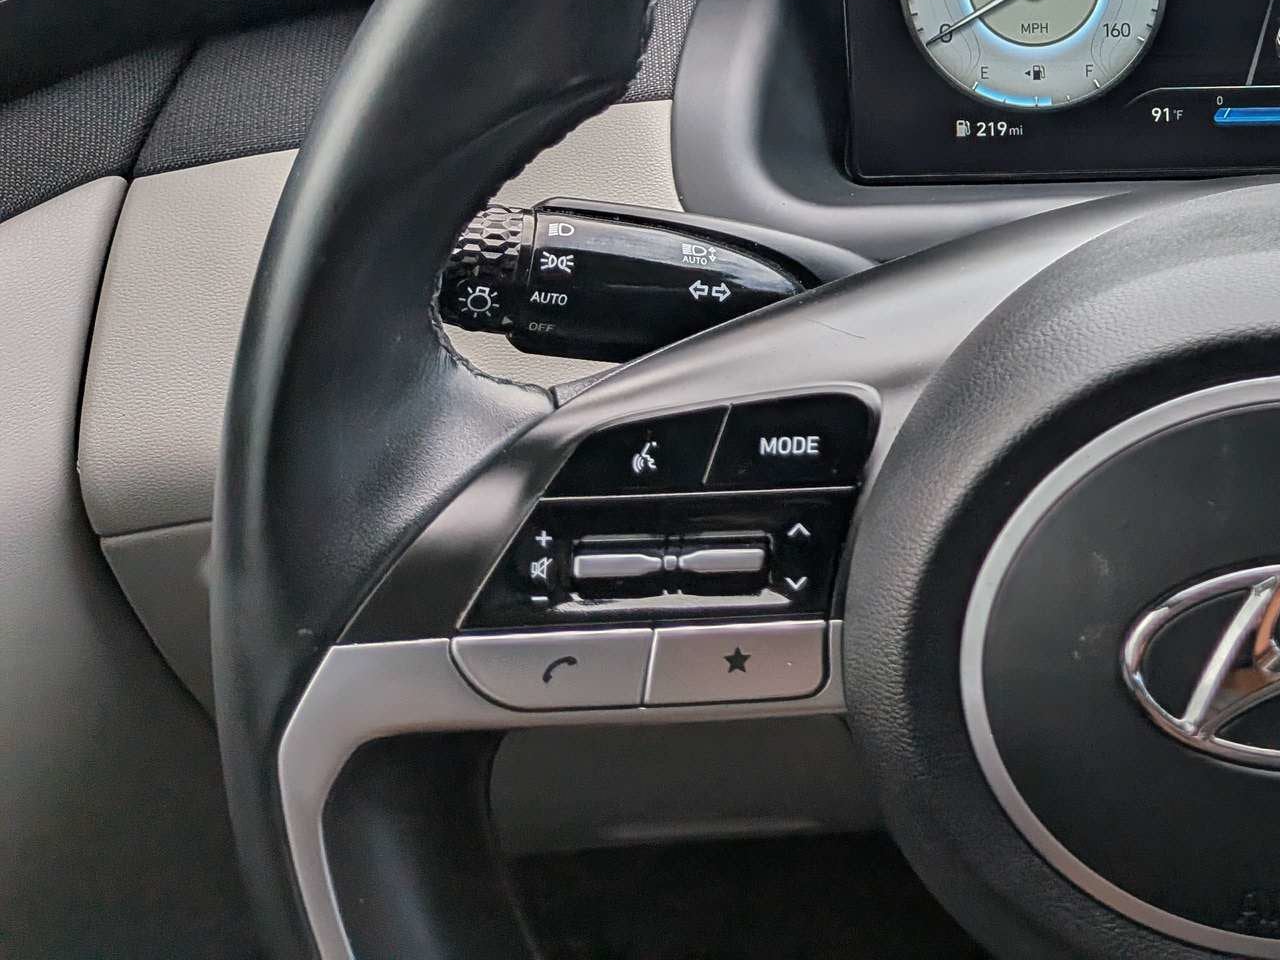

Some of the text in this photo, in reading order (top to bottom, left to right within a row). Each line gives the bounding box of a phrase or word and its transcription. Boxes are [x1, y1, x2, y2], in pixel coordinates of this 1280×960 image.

[1020, 22, 1049, 35] MPH
[1103, 22, 1131, 38] 160
[980, 66, 989, 80] E
[1085, 64, 1093, 78] F
[1216, 96, 1223, 106] 0
[1151, 107, 1171, 122] 91
[976, 121, 1008, 137] 219
[682, 255, 708, 265] AUTO
[530, 291, 568, 306] AUTO
[529, 321, 555, 333] OFF
[760, 436, 819, 456] MODE
